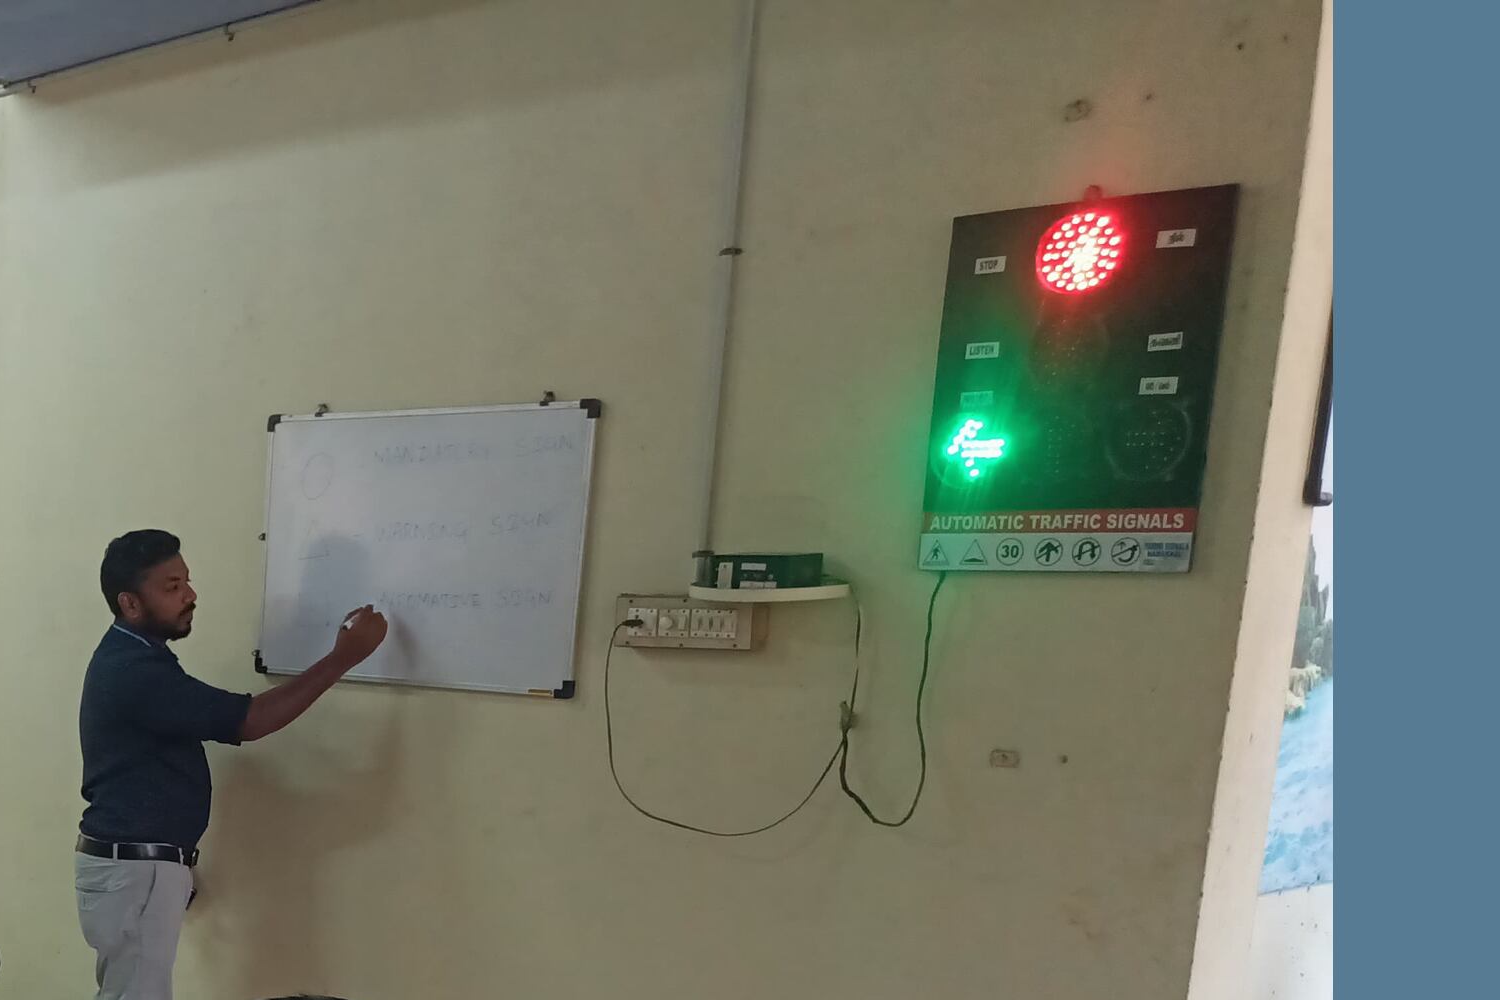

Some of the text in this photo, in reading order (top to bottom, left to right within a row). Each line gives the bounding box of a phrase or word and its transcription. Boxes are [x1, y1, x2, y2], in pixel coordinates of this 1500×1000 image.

[979, 260, 998, 270] STOP
[969, 345, 995, 356] LISTEN
[930, 512, 1185, 530] AUTOMATIC TRAFFIC SIGNALS
[1000, 544, 1019, 558] 30
